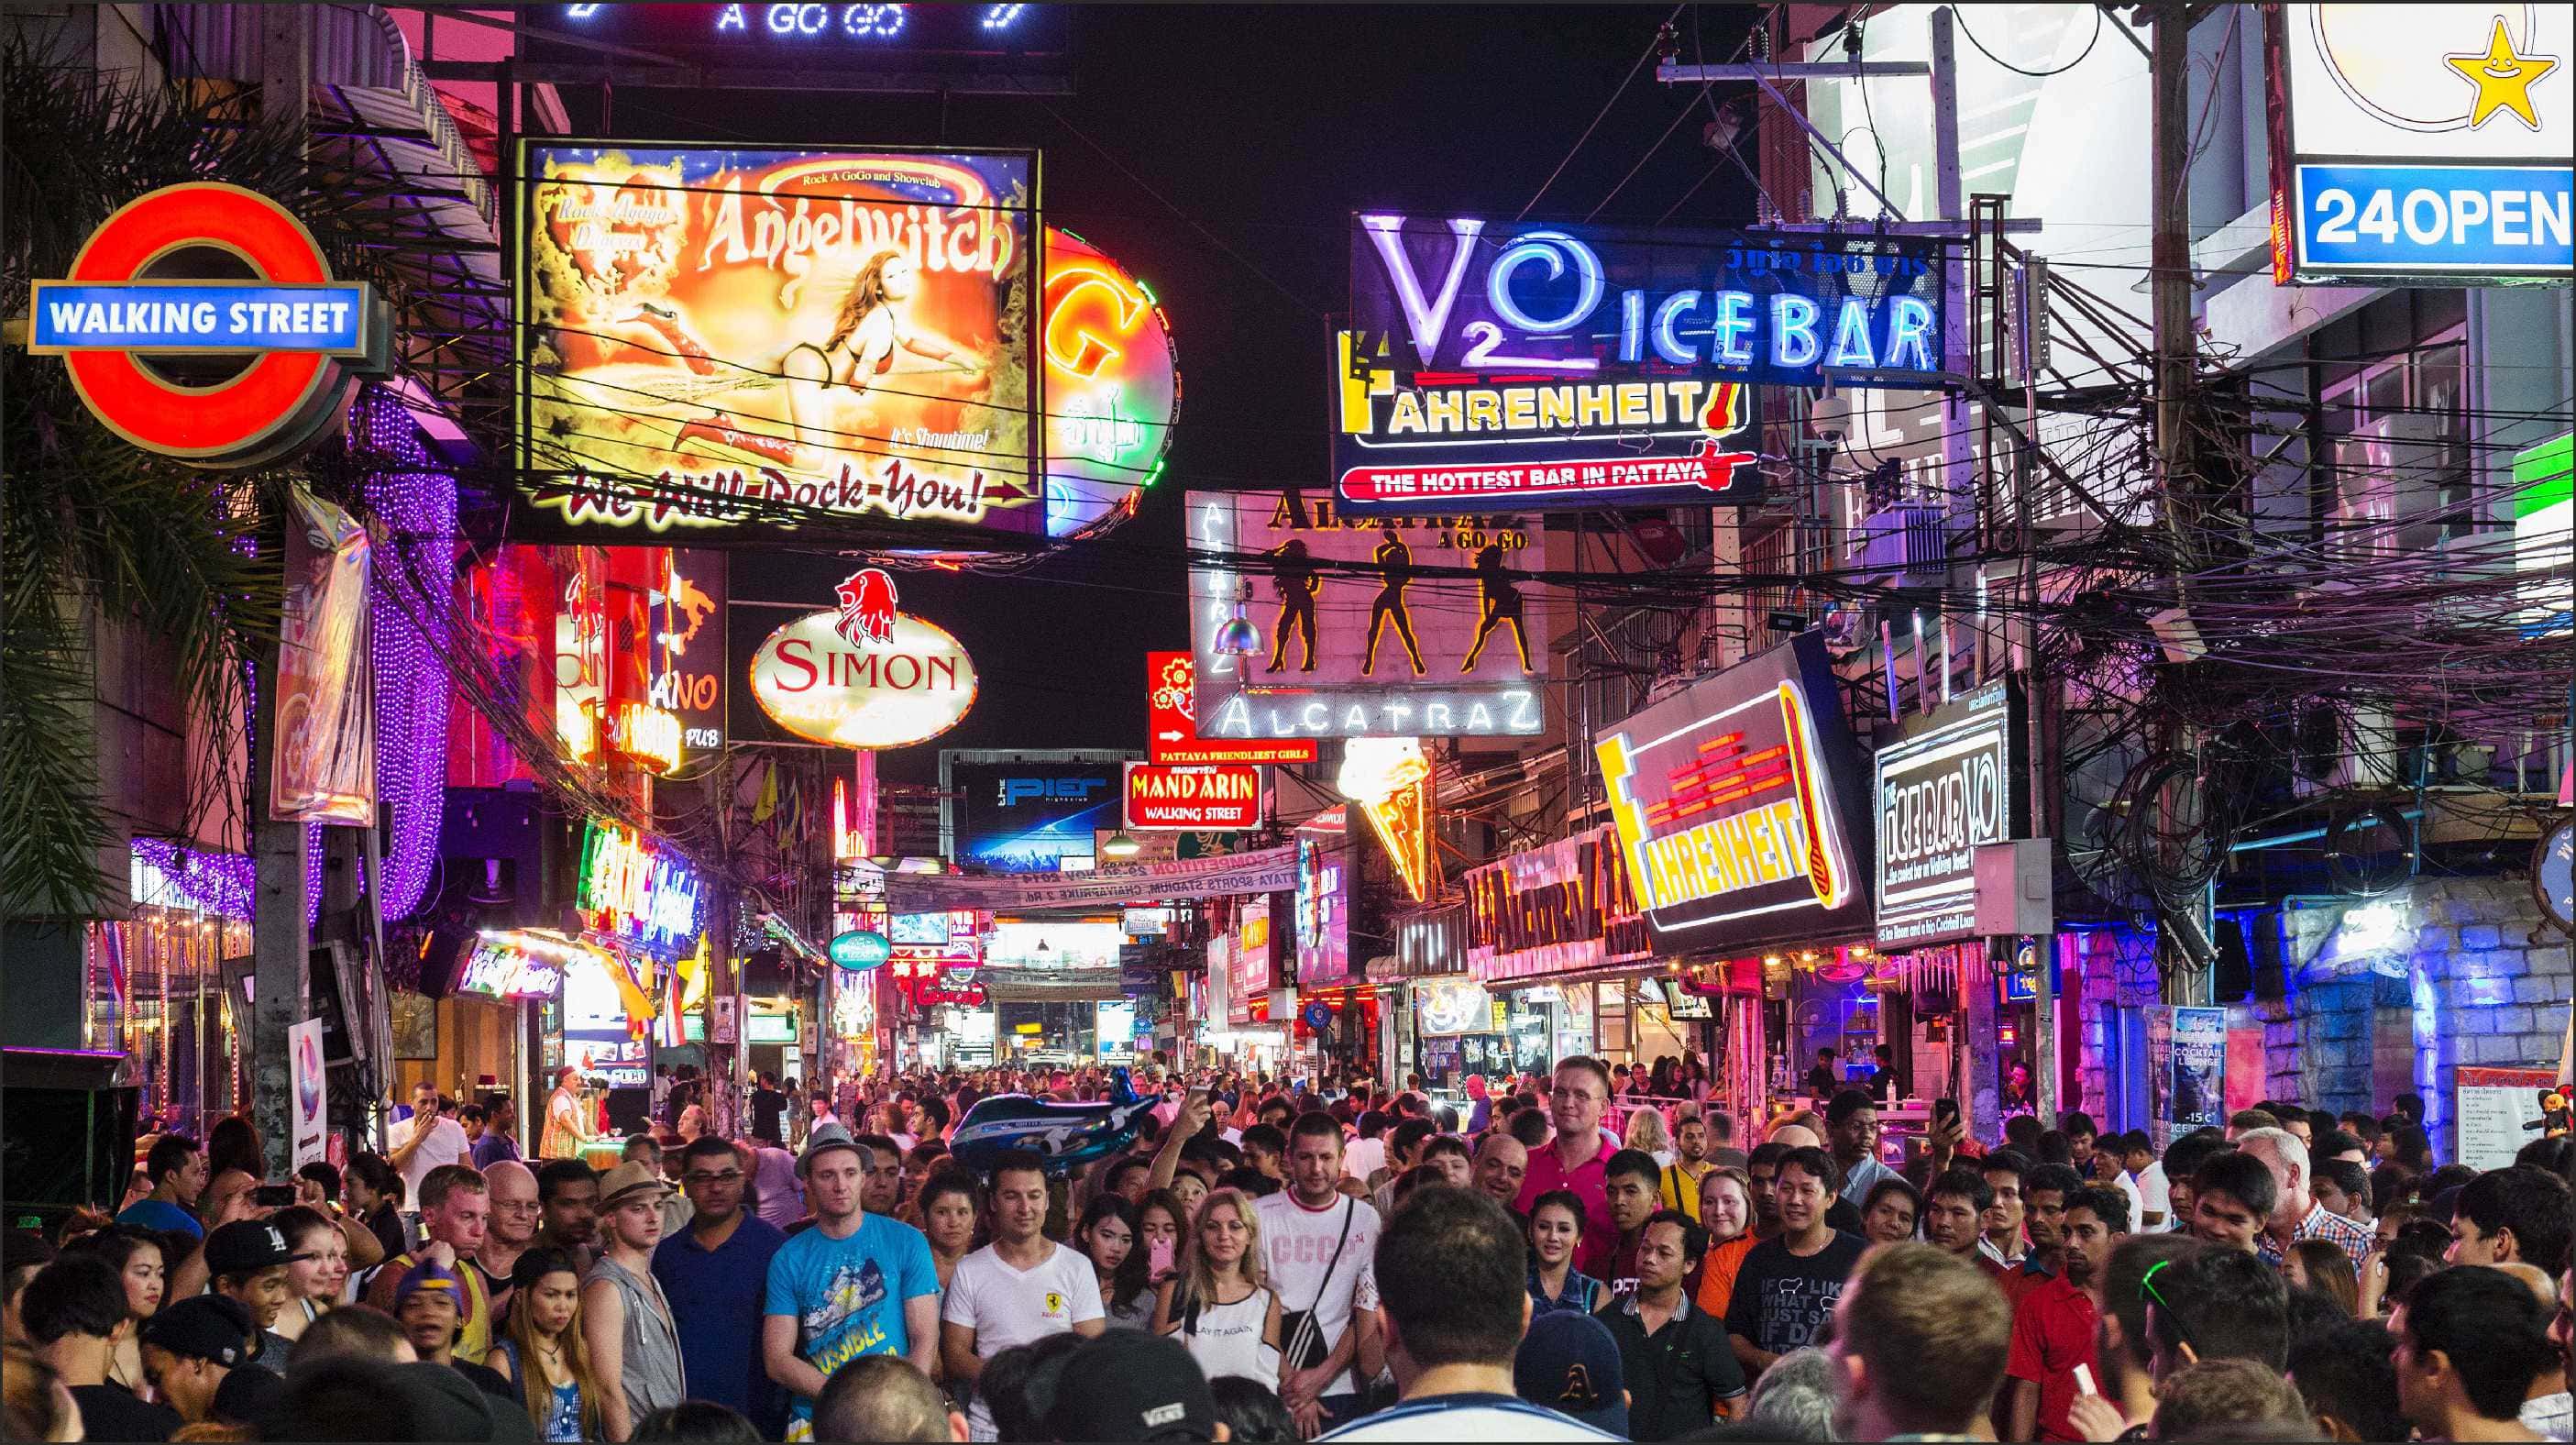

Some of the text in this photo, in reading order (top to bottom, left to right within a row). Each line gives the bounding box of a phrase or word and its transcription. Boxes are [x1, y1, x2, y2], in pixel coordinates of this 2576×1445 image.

[768, 3, 827, 33] GO
[843, 3, 903, 34] GO
[803, 171, 941, 189] Rock A GoGo and Showclub
[696, 174, 1014, 310] Angelwitch
[50, 301, 348, 336] WALKING STREET
[1338, 330, 1703, 435] FAHRENHEIT
[889, 426, 989, 451] It's Showtime!
[1371, 461, 1708, 494] THE HOTTEST BAR IN PATTAYA
[1437, 529, 1528, 551] A GO GO
[773, 637, 959, 693] SIMON
[649, 670, 718, 711] ANO
[1221, 690, 1540, 736] ALCATRAZ
[686, 728, 719, 747] PUB
[1160, 749, 1310, 762] PATTAYA FRIENDLIEST GIRLS
[1131, 773, 1254, 800] MANDARIN
[1885, 781, 1897, 810] THE
[1145, 807, 1243, 822] WALKING STREET
[1595, 733, 1810, 911] FAHRENHEIT
[1271, 1235, 1357, 1264] CCCP
[1809, 1279, 1844, 1296] LIK
